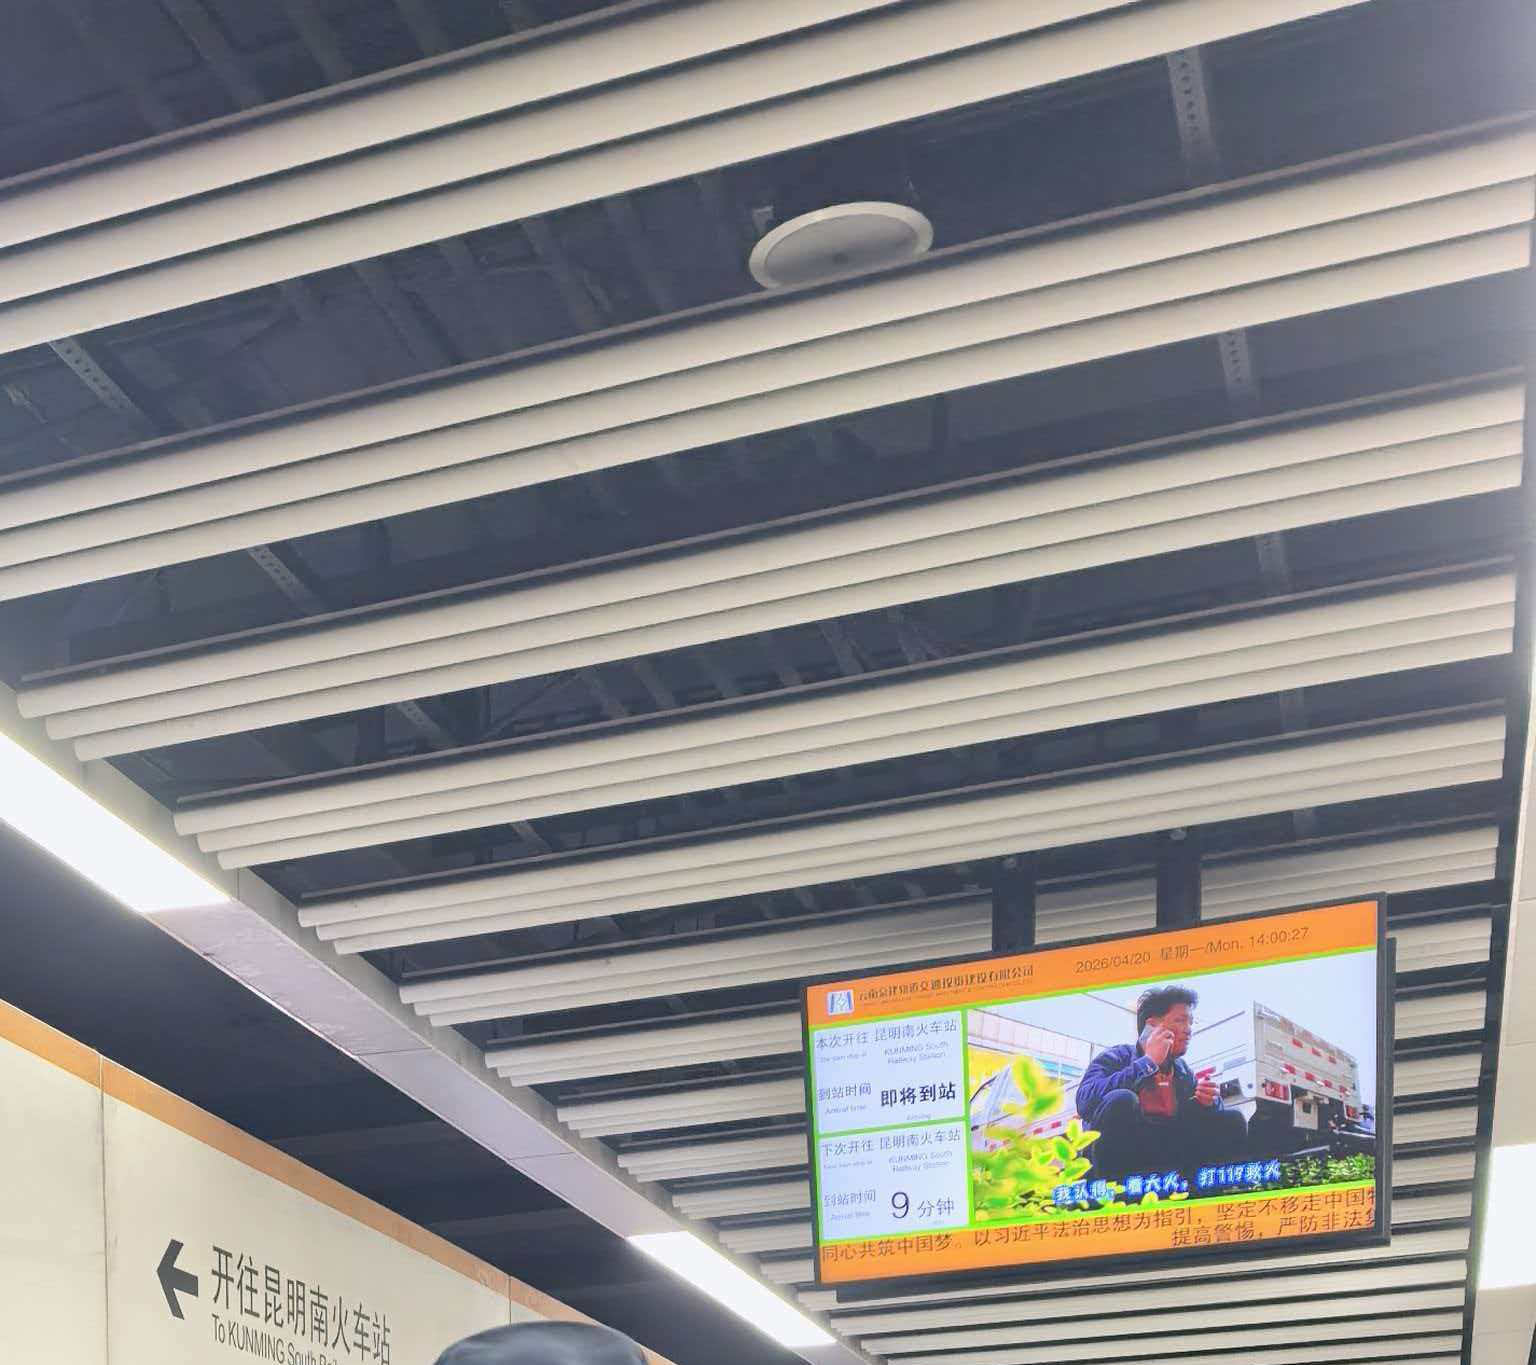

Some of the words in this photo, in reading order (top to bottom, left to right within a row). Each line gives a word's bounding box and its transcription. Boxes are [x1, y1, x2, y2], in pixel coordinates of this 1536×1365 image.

[1075, 951, 1152, 975] 2026/04/20
[1249, 926, 1310, 949] 14:00:27
[874, 1019, 957, 1042] 昆明南火车站
[818, 1080, 872, 1101] 到站时间
[880, 1081, 957, 1108] 即将到站
[880, 1127, 961, 1151] 昆明南火车站
[891, 1191, 910, 1219] 9
[917, 1197, 955, 1219] 分钟
[212, 1313, 225, 1343] To
[228, 1321, 285, 1365] KUNMING
